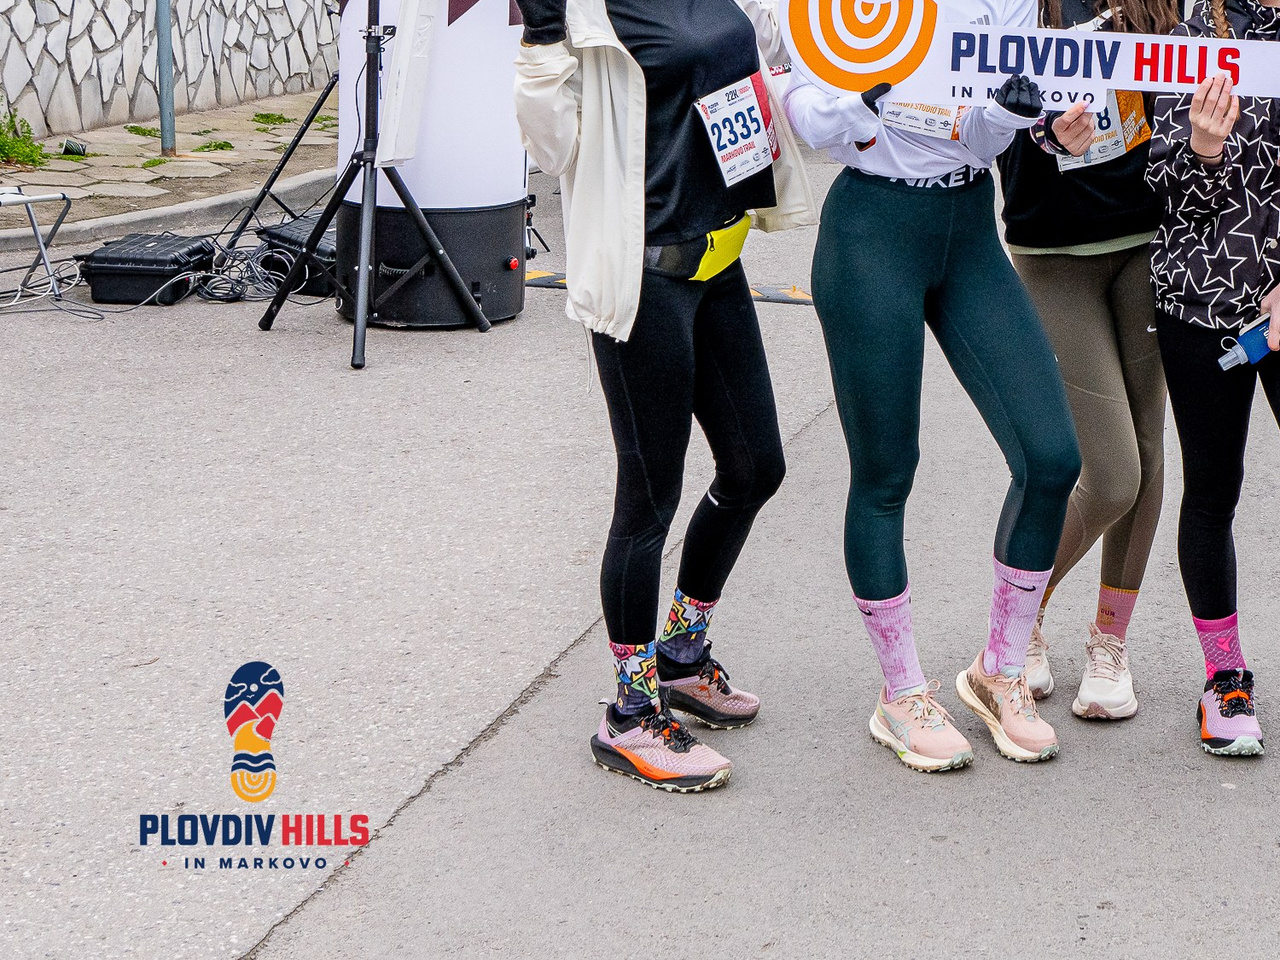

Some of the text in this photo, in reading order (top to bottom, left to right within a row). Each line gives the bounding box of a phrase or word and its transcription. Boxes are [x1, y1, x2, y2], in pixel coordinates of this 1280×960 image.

[950, 32, 1241, 87] PLOVDIV HILLS
[950, 85, 1096, 106] IN MKOVO
[710, 105, 761, 152] 2335
